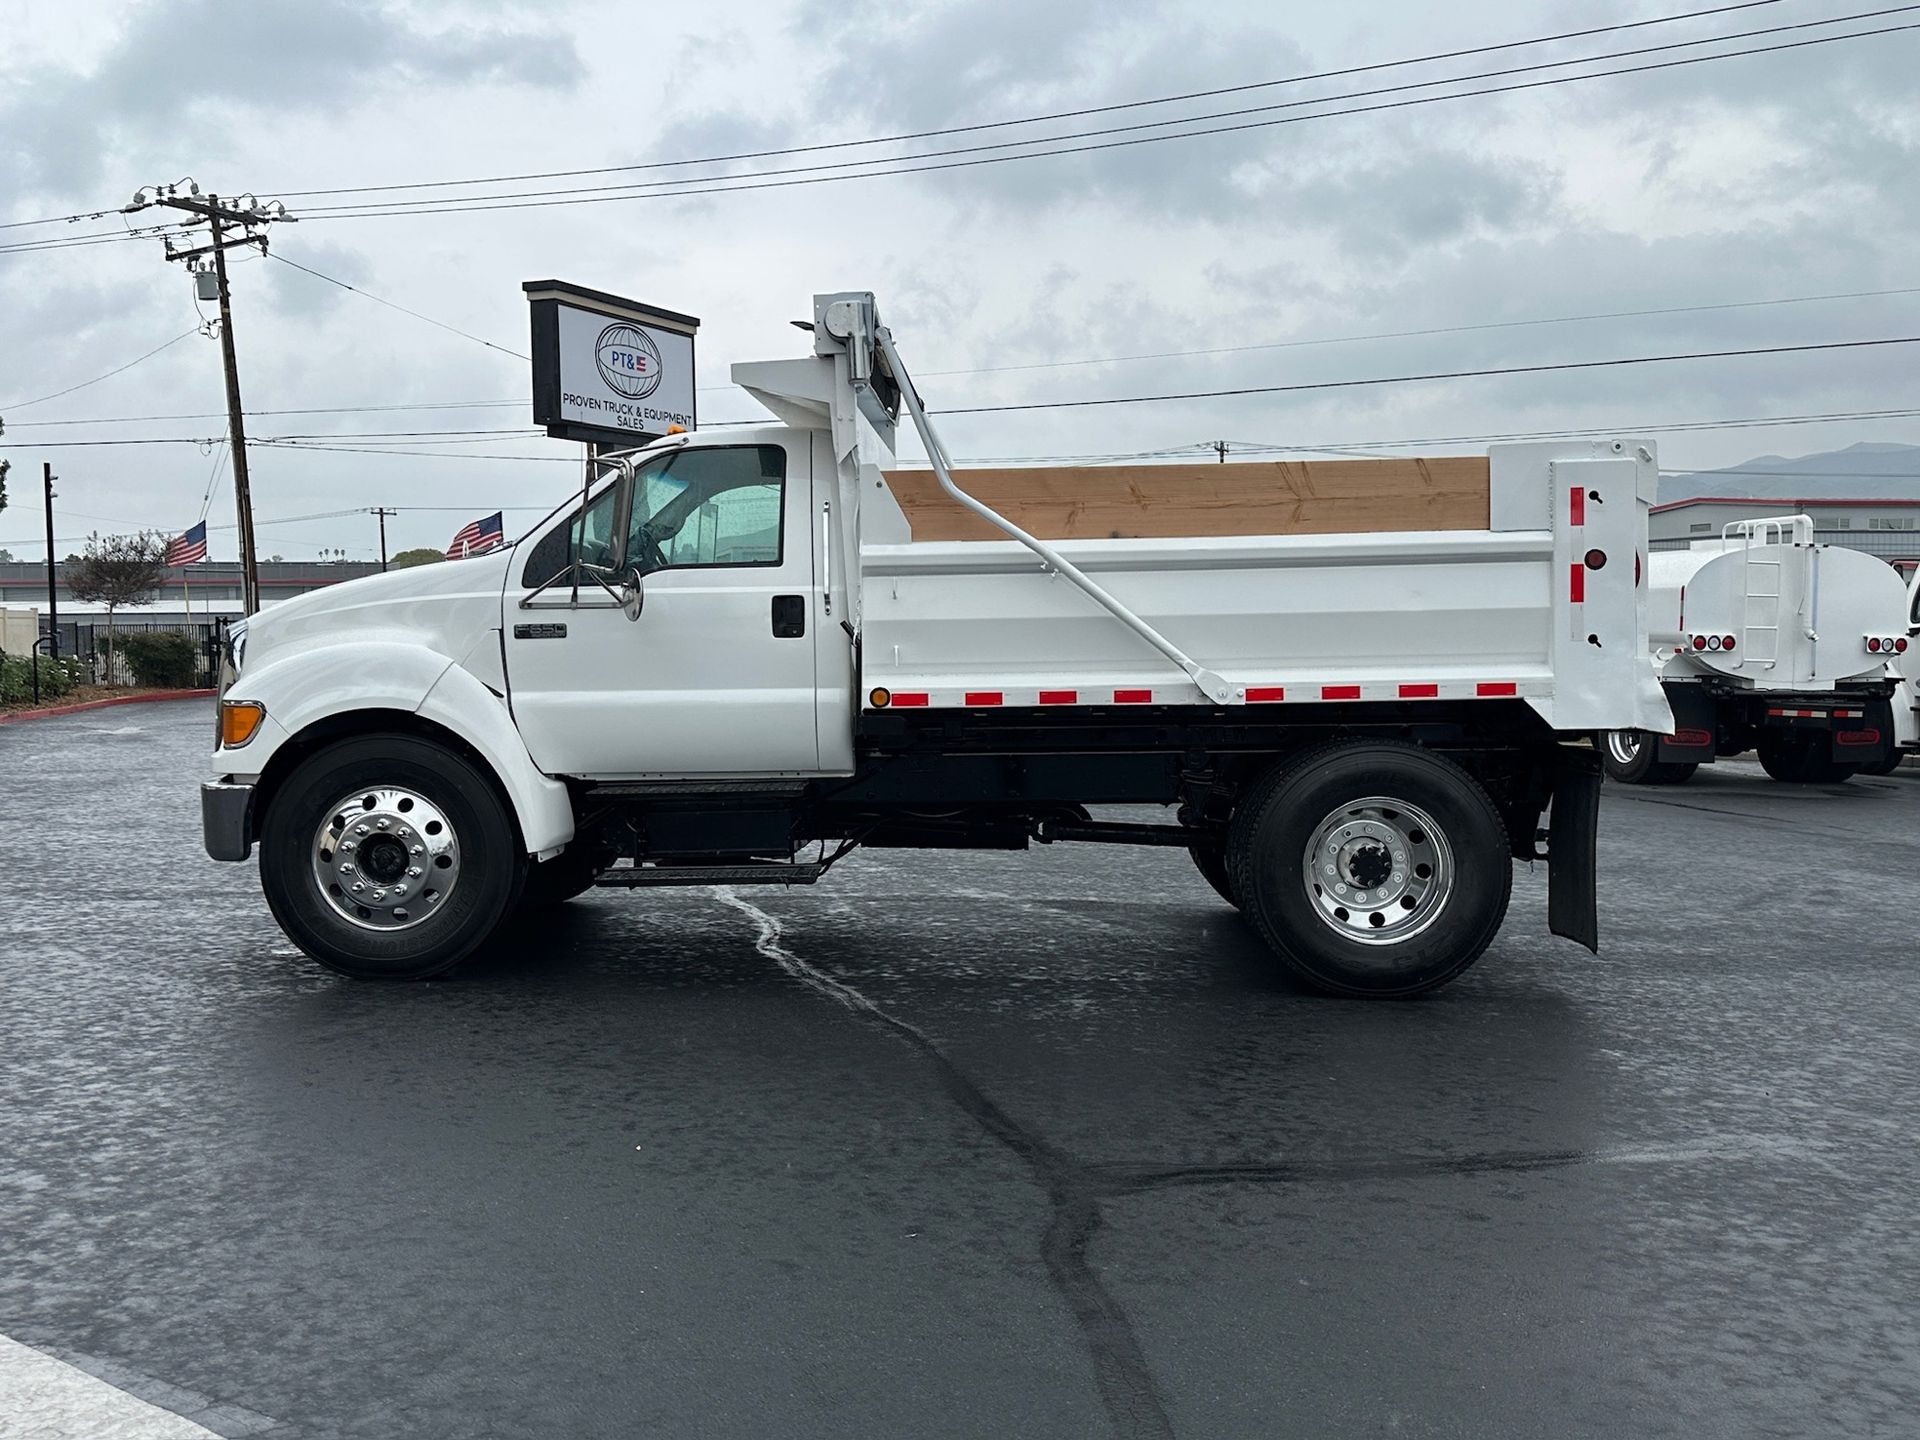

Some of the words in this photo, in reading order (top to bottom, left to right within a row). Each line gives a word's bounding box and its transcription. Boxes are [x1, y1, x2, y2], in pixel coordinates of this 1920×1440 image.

[612, 350, 646, 372] PT&E
[562, 393, 601, 410] PROVEN
[603, 400, 634, 416] TRUCK
[636, 406, 642, 417] &
[644, 408, 692, 426] EQUIPMENT
[617, 415, 644, 430] SALES
